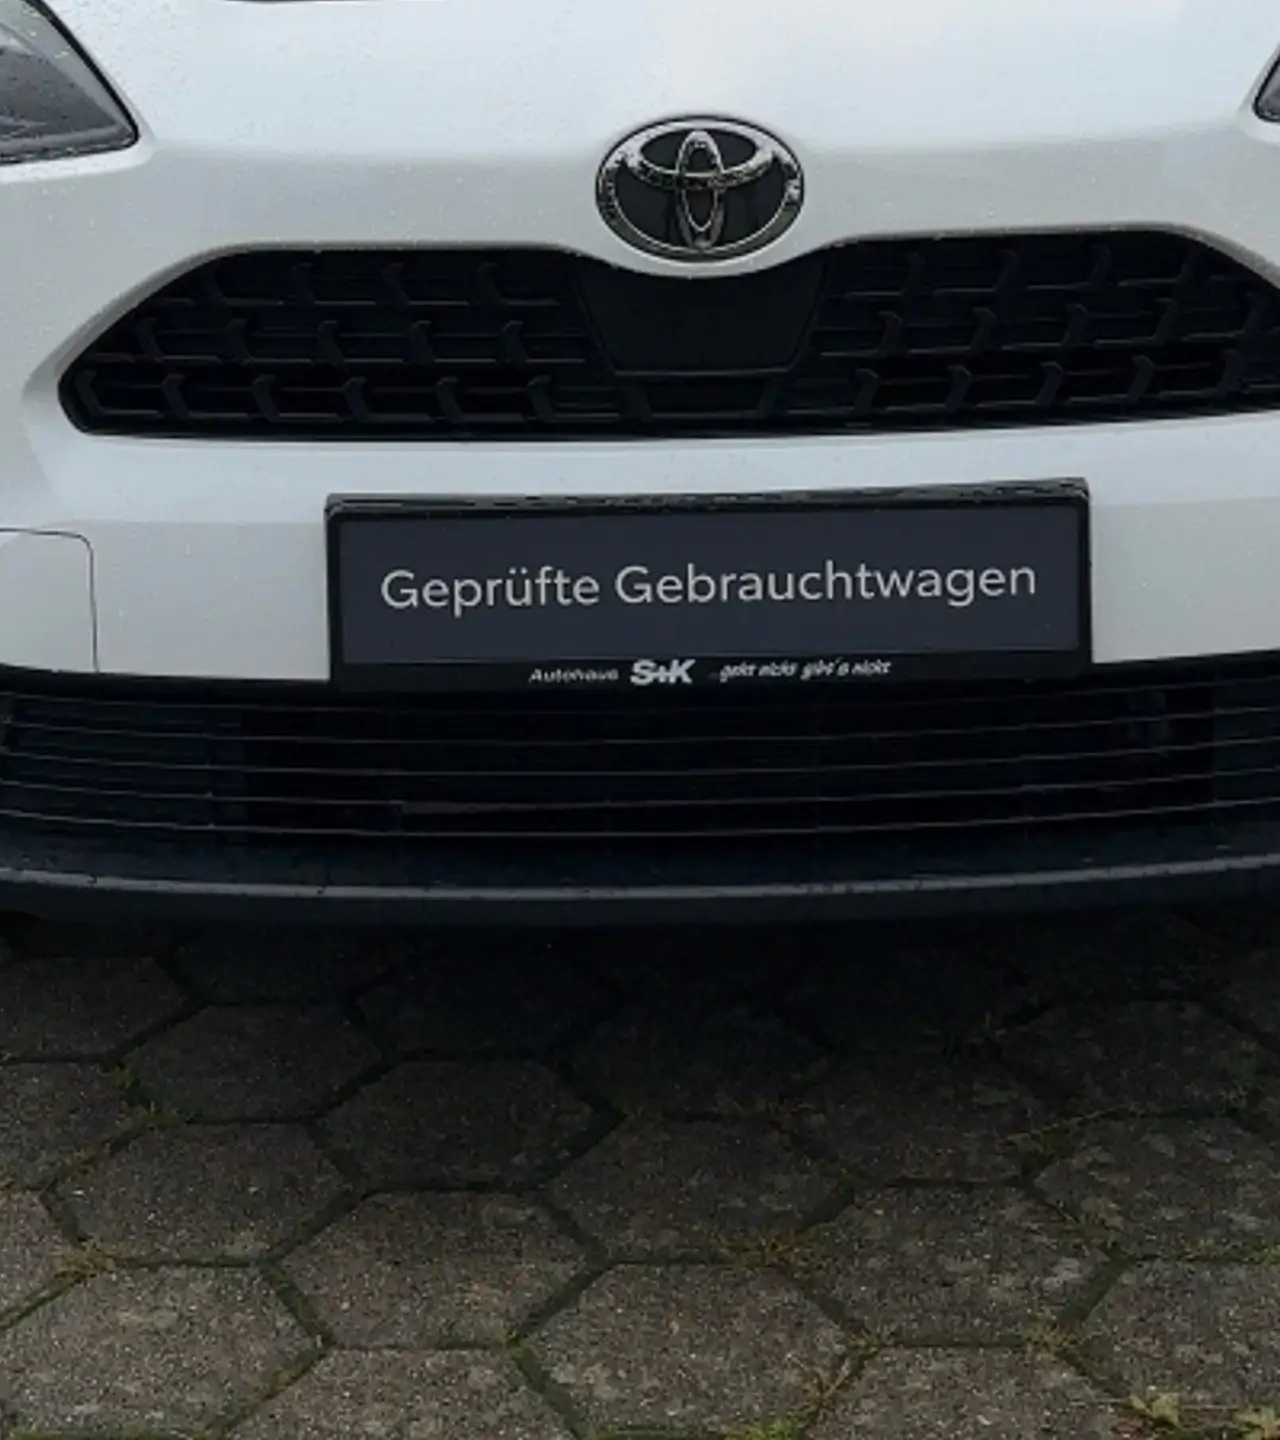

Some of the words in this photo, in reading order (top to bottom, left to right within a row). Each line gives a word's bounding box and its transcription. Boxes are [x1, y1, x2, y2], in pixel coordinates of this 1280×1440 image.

[380, 565, 601, 618] Geprüfte
[615, 559, 1036, 607] Gebrauchtwagen
[528, 667, 619, 683] Autohaus
